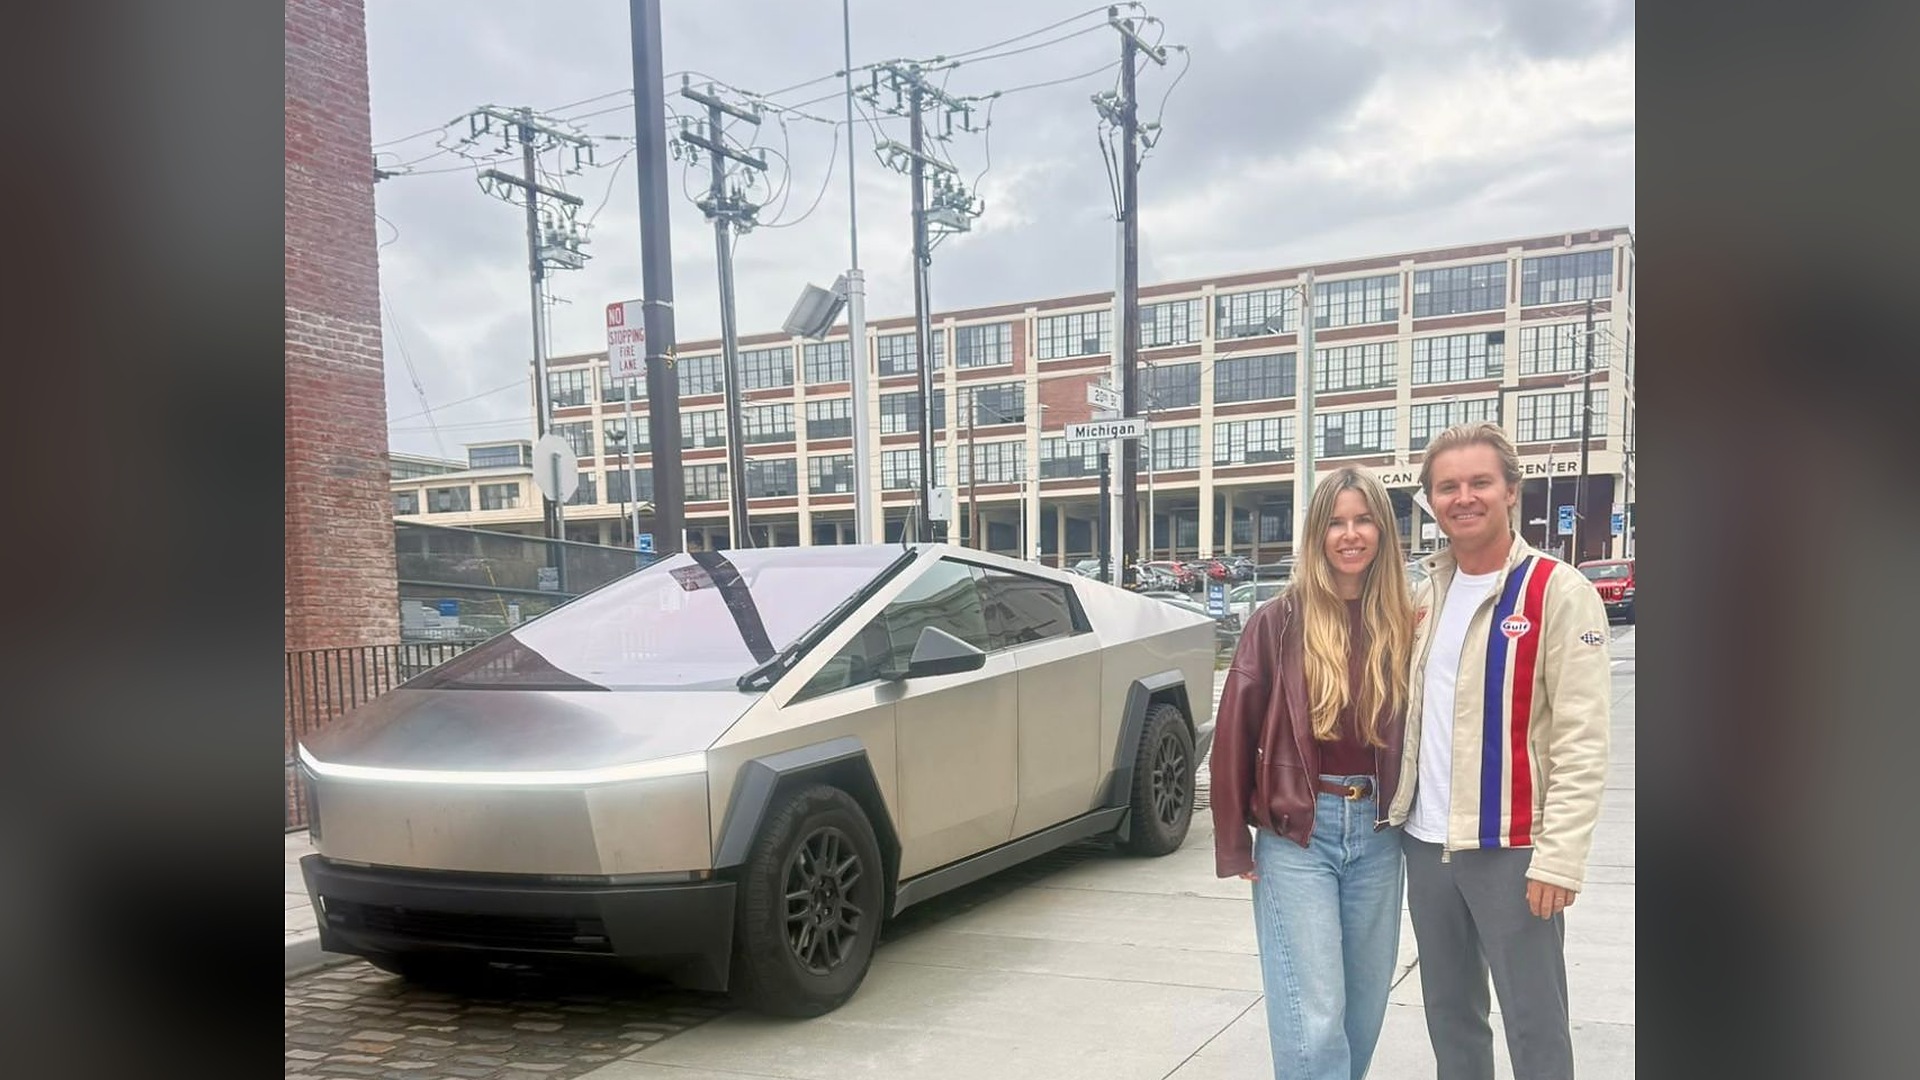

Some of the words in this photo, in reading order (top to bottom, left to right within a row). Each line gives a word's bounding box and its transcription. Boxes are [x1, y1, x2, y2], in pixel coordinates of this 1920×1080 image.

[608, 308, 621, 325] NO
[609, 328, 645, 345] STOPPING
[620, 345, 635, 357] FIRE
[620, 359, 636, 371] LANE
[1075, 424, 1135, 439] Michigan
[1378, 473, 1412, 484] CAN
[1502, 621, 1528, 630] Gulf
